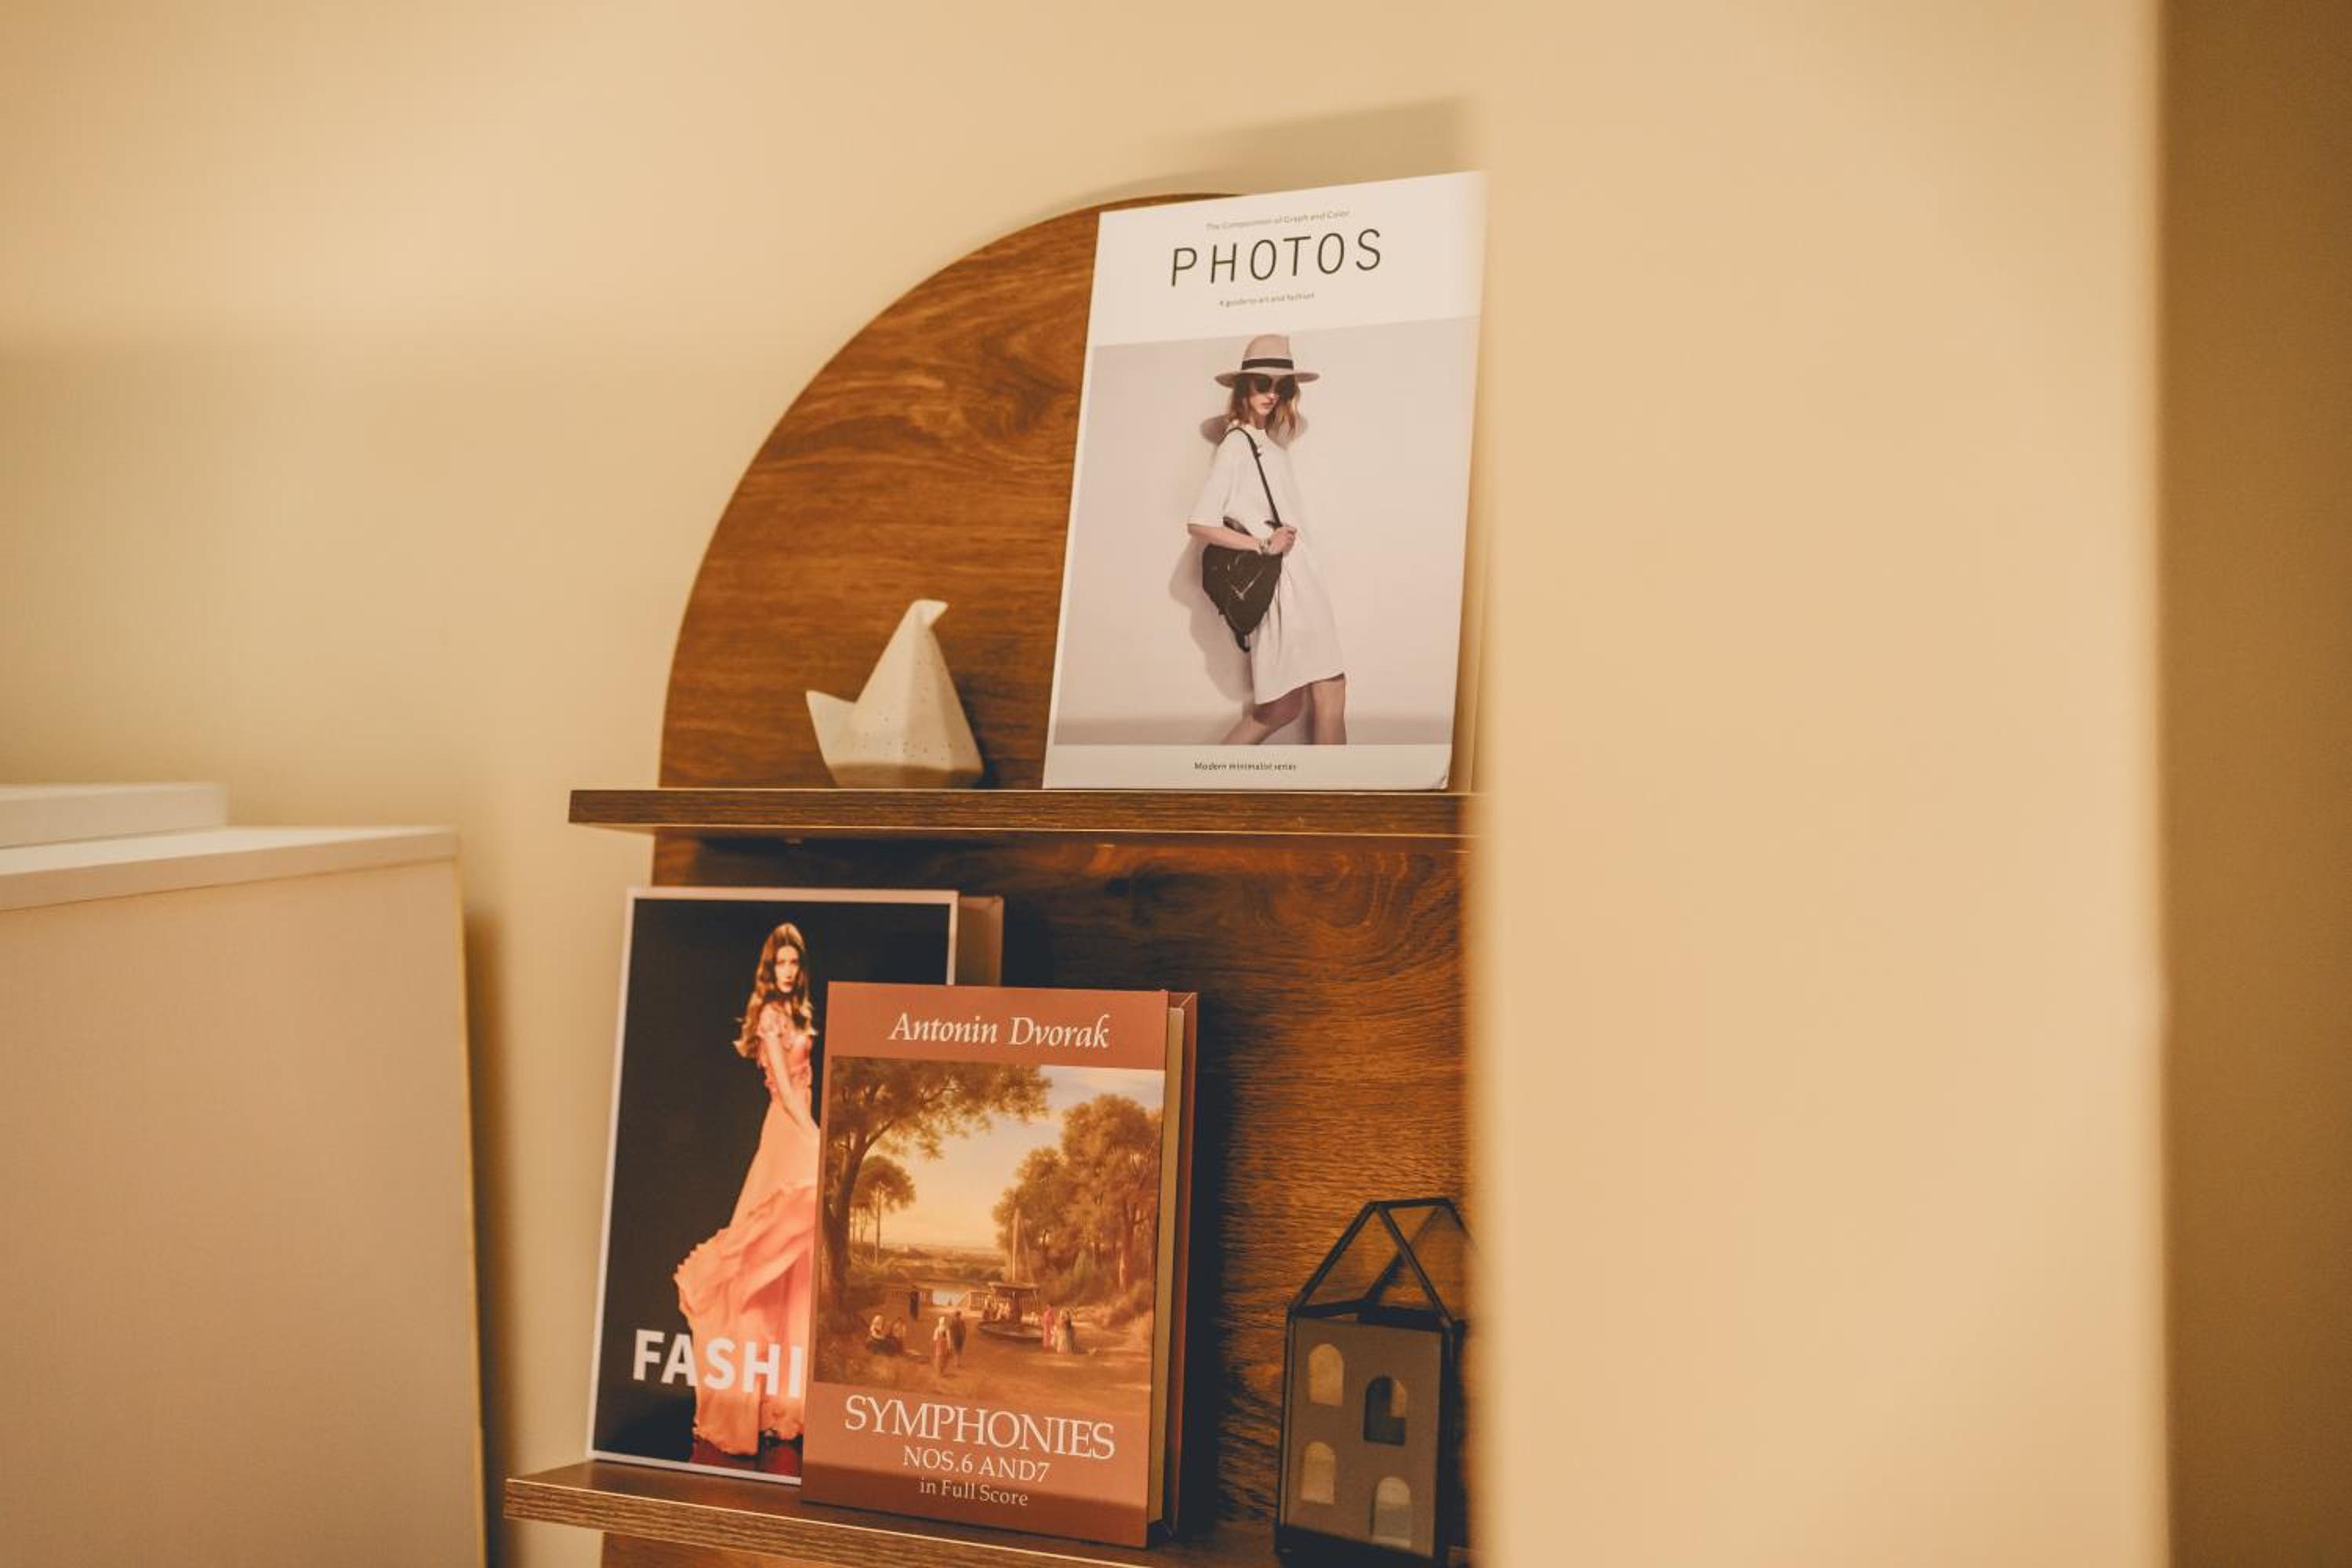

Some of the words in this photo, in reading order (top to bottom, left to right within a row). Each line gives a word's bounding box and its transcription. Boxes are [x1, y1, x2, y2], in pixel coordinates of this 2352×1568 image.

[1171, 228, 1381, 287] PHOTOS
[1194, 762, 1227, 771] Modern
[1229, 761, 1272, 771] minimalist
[1274, 762, 1297, 771] series
[887, 1012, 999, 1044] Antonin
[1004, 1014, 1111, 1048] Dvorak
[633, 1329, 804, 1399] FASHI
[844, 1394, 1116, 1461] SYMPHONIES
[903, 1446, 974, 1474] NOS.6
[920, 1477, 937, 1495] in
[941, 1479, 975, 1501] Full
[979, 1483, 1029, 1507] Score
